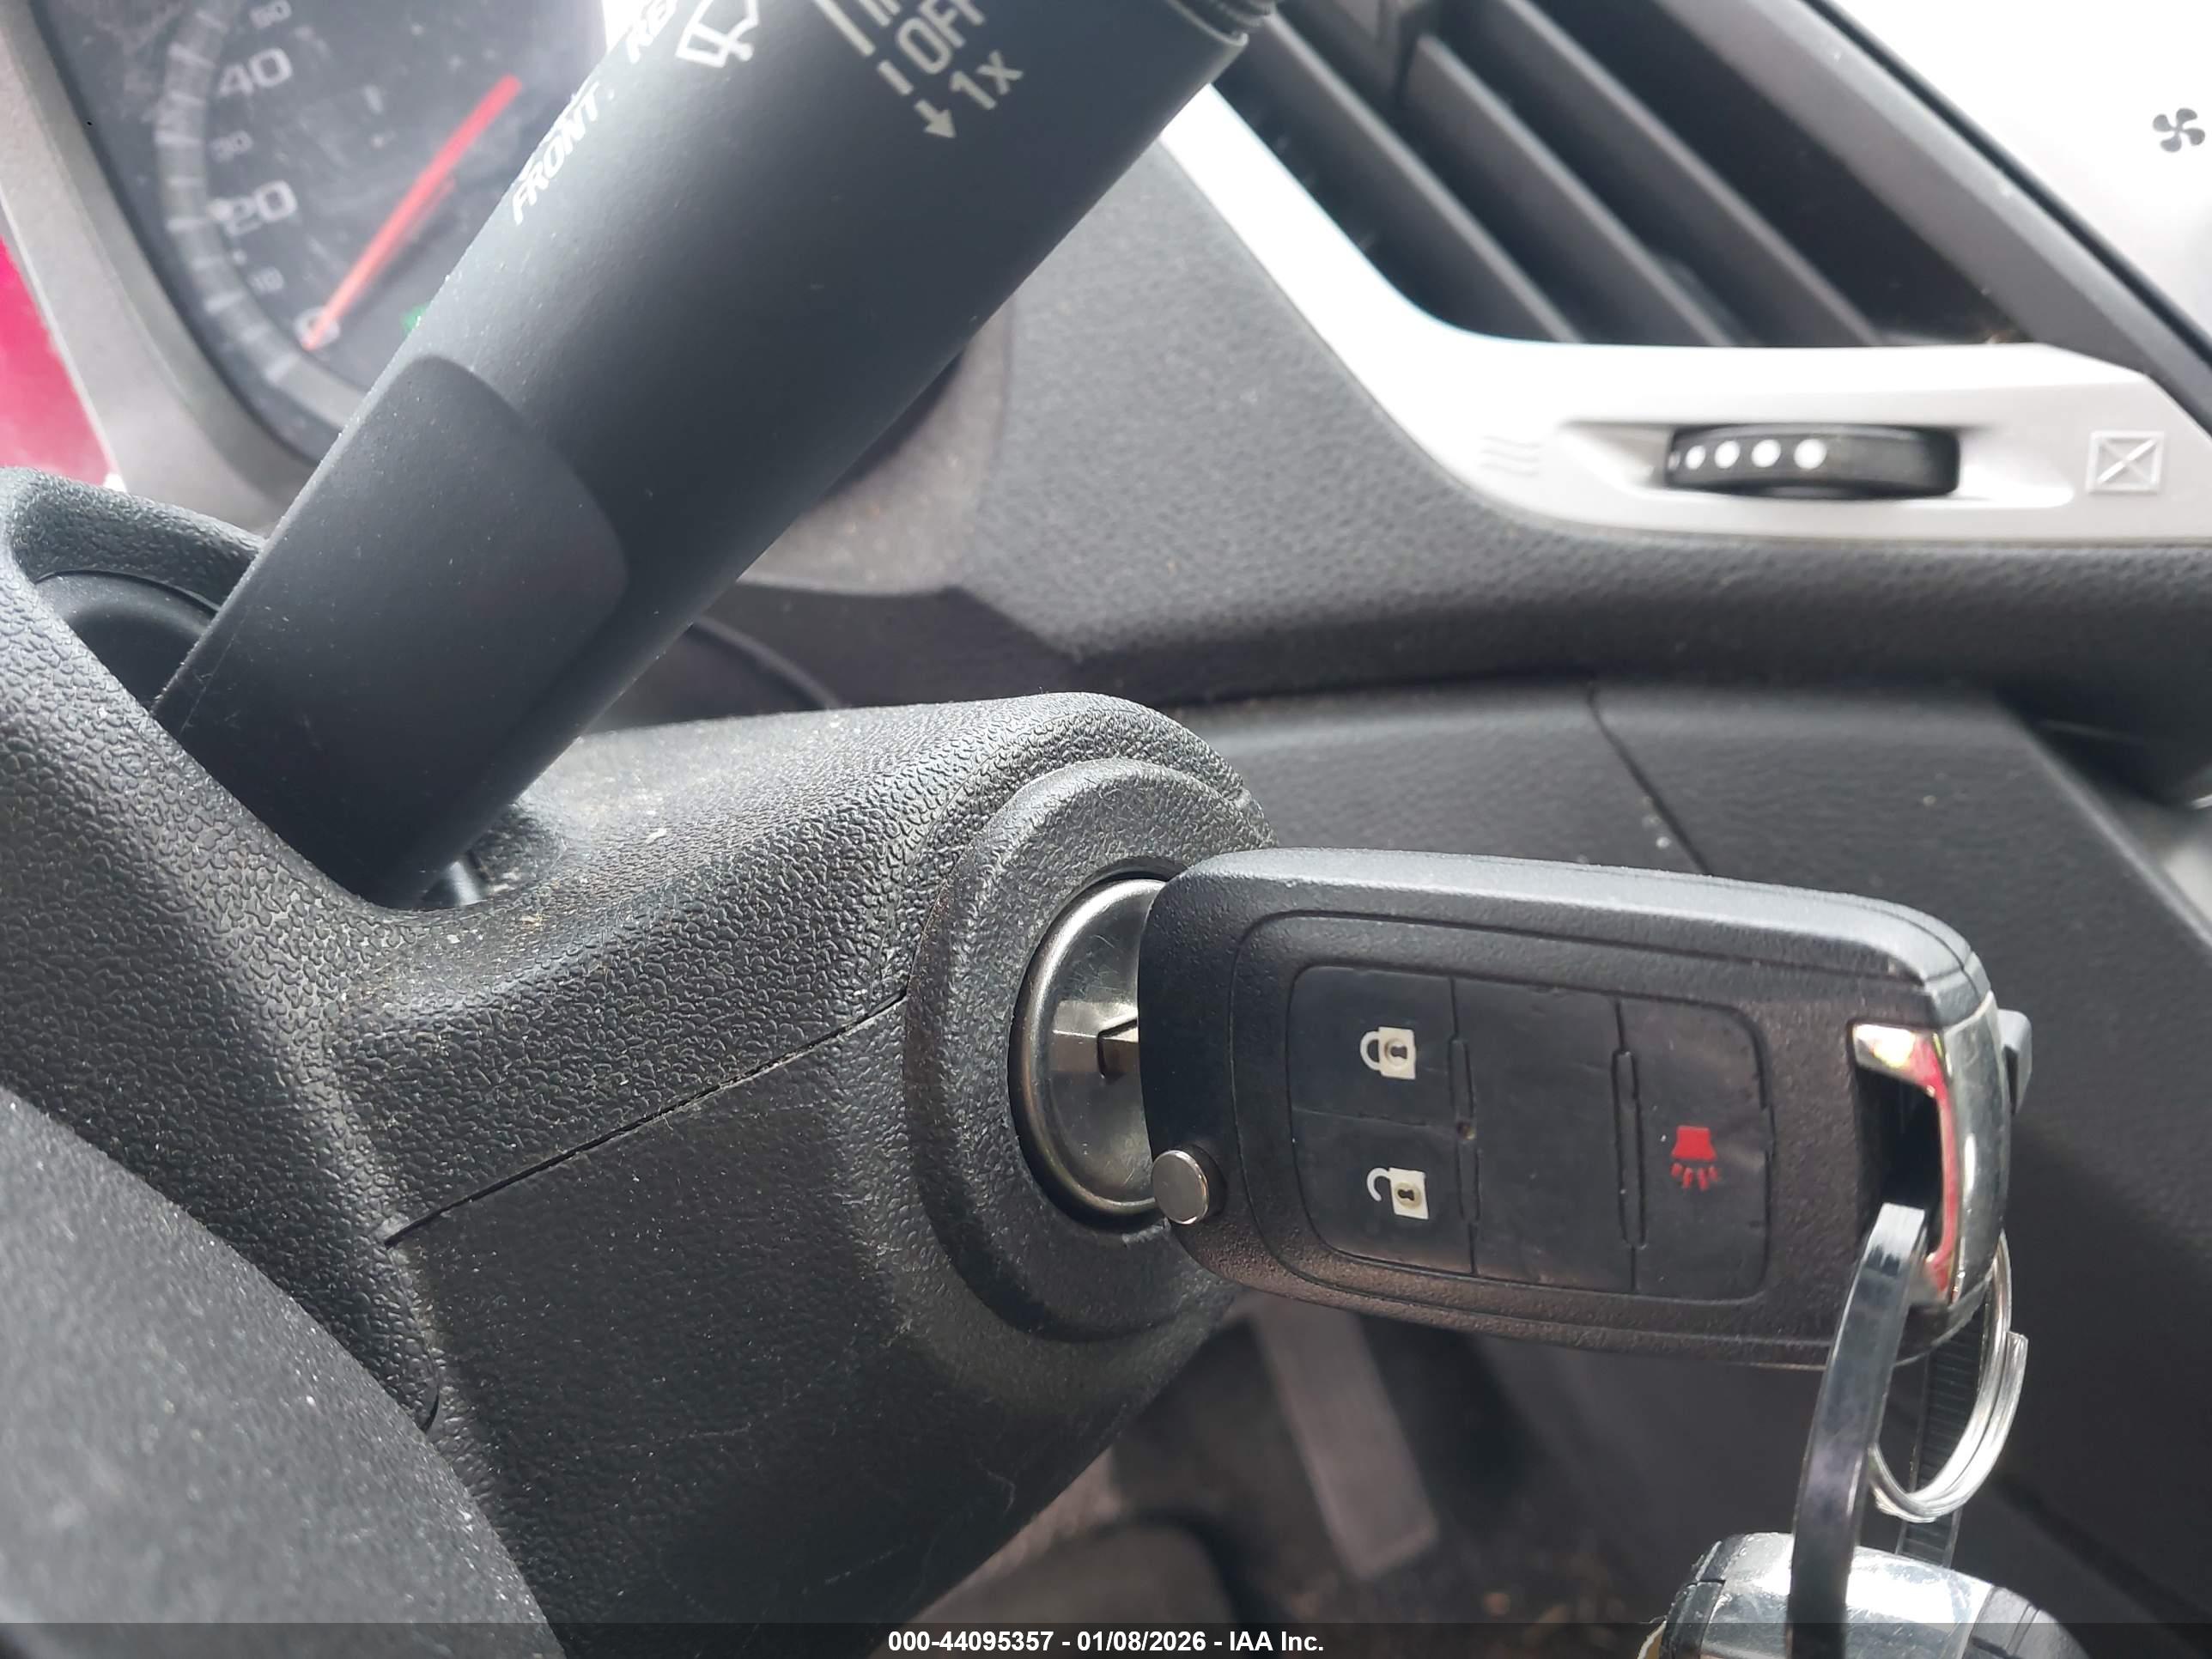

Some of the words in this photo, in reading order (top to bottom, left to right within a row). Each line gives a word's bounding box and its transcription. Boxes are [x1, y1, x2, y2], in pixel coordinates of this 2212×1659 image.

[218, 49, 292, 96] 40
[512, 81, 599, 225] FRONT
[208, 179, 297, 236] 20
